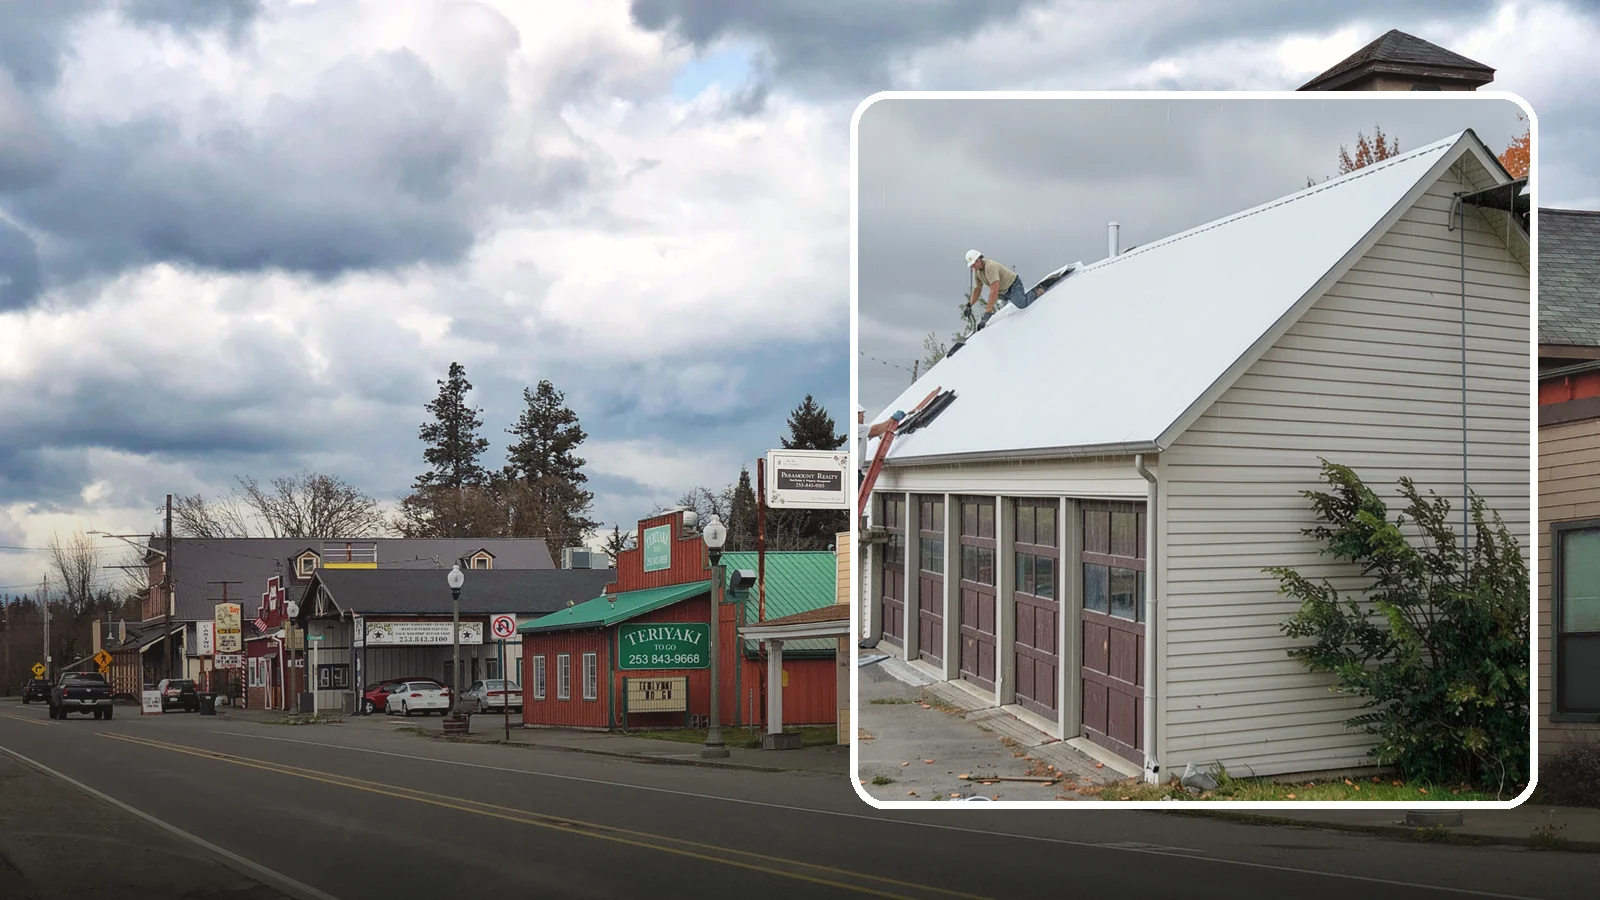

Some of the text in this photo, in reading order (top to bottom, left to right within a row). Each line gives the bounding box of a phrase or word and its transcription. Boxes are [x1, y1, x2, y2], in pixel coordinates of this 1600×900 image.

[781, 471, 814, 479] PARAMOUNT
[625, 627, 702, 646] TERIYAKI
[629, 654, 700, 665] 253 843-9668
[639, 681, 673, 691] TERIYAKI
